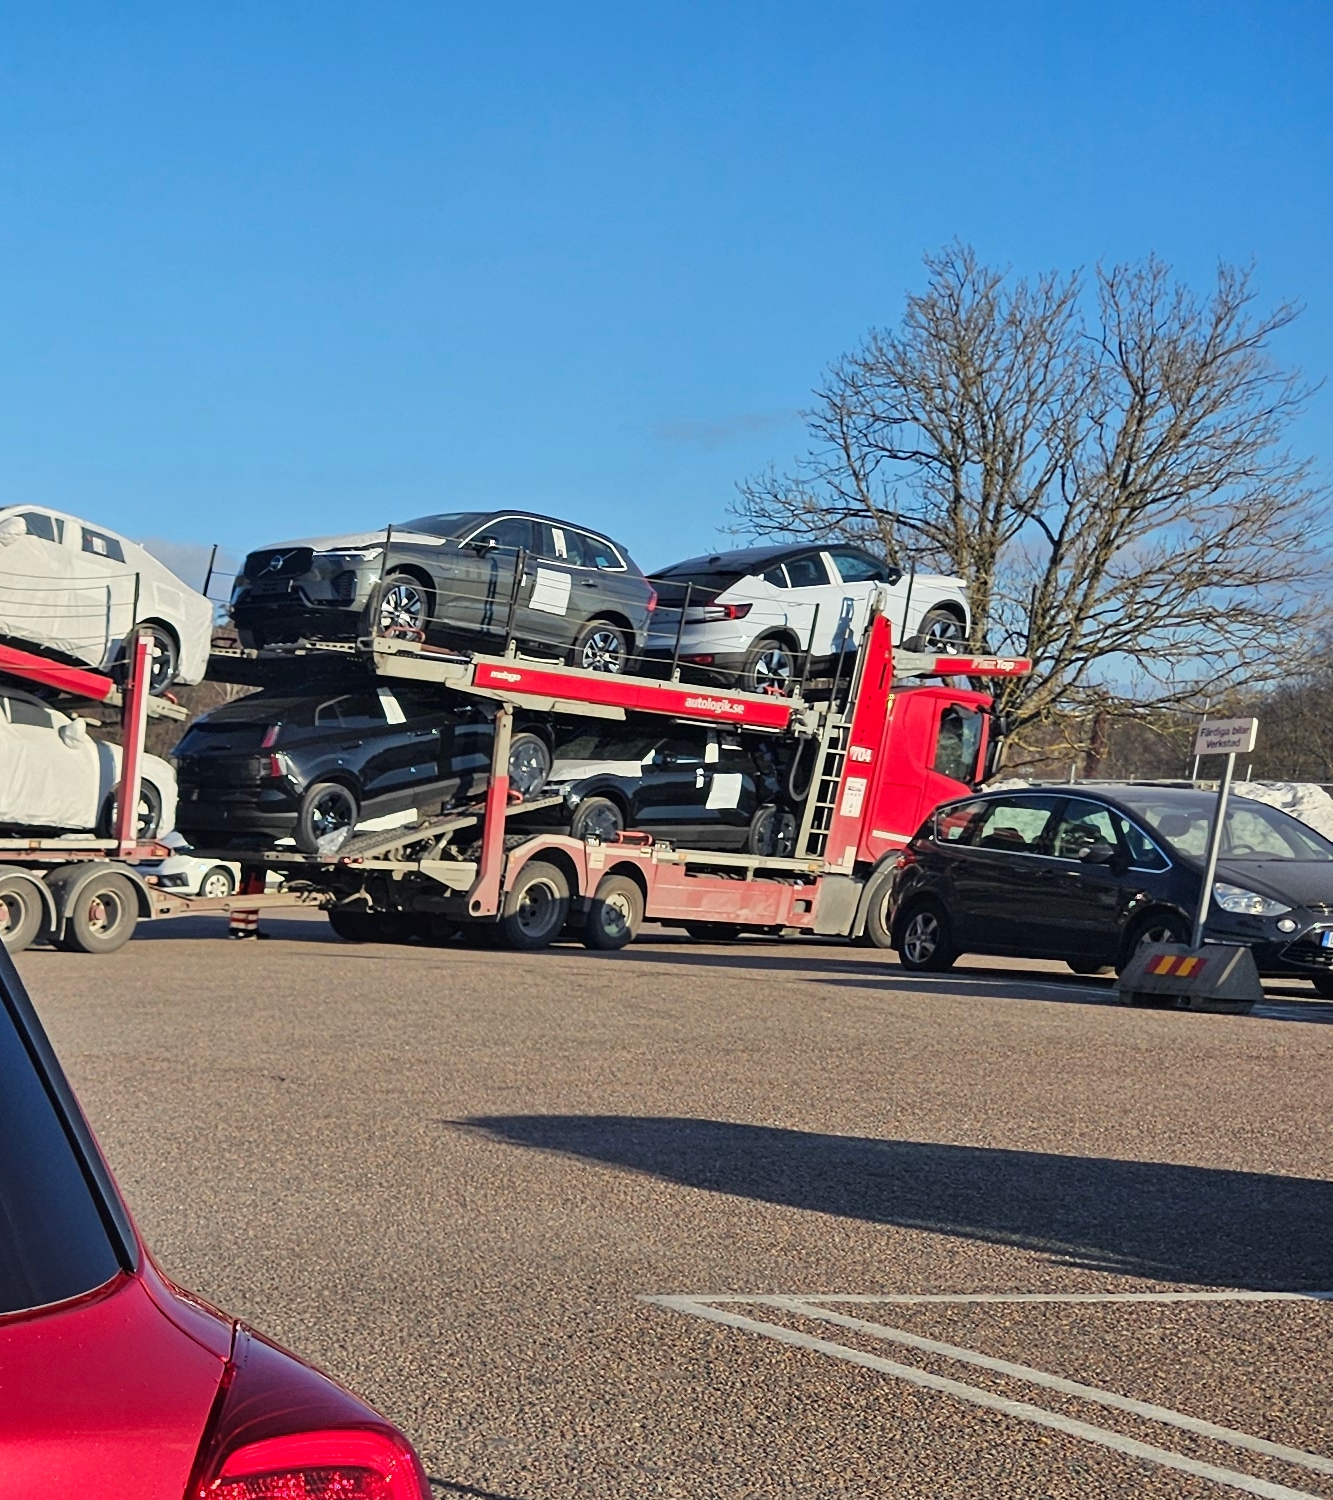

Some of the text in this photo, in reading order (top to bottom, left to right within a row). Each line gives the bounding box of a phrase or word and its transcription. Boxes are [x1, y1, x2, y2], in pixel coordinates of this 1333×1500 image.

[684, 697, 745, 715] autologik.se
[1200, 727, 1230, 738] Färdiga
[1206, 738, 1241, 748] Verkstad
